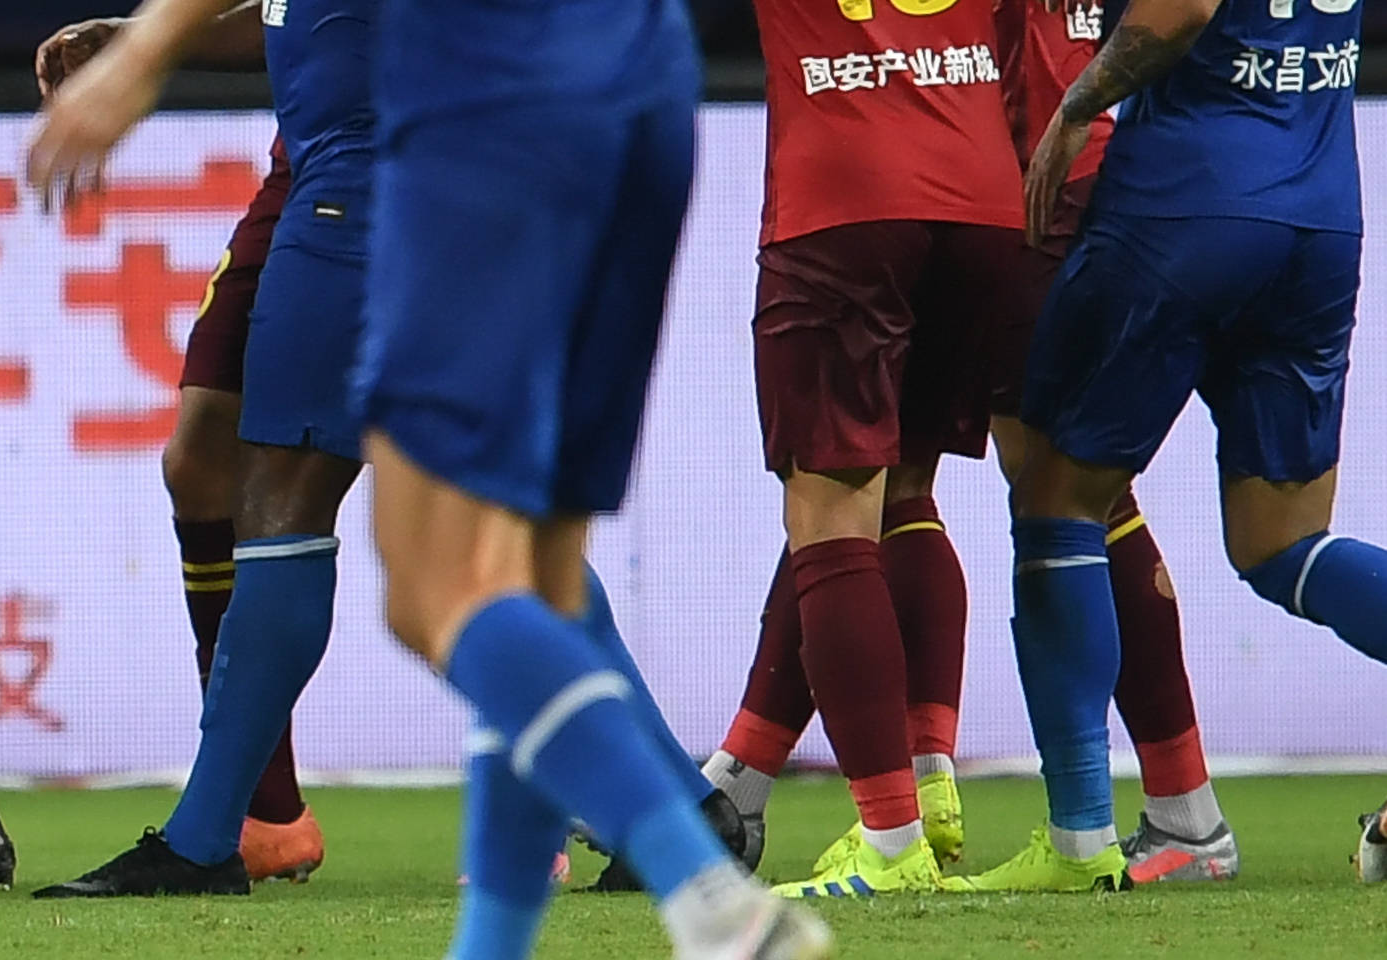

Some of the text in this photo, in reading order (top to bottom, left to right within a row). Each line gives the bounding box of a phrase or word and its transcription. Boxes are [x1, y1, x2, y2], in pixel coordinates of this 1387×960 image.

[799, 43, 1001, 96] 固安产业新城
[1230, 37, 1360, 94] 永昌文旅
